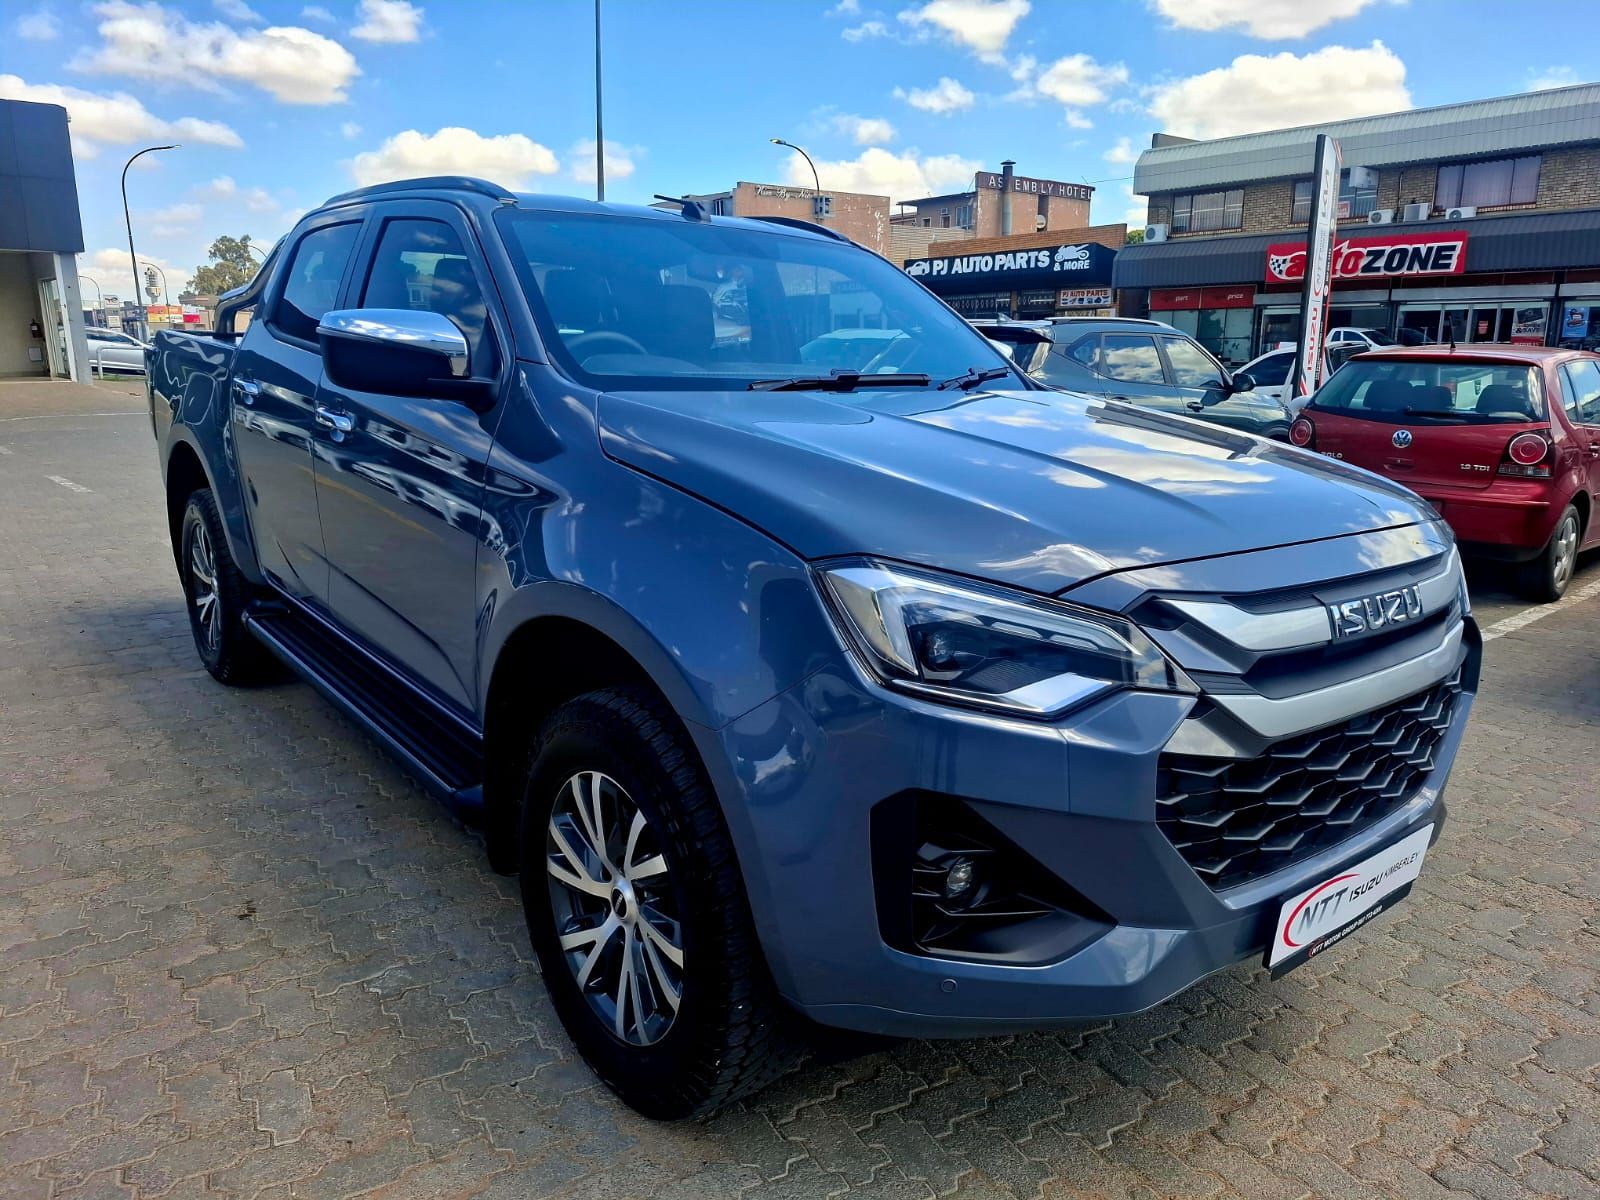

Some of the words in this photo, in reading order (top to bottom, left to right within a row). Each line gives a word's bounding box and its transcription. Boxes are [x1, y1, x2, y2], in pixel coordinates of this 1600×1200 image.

[988, 175, 1053, 195] ASEMBLY
[1059, 184, 1092, 200] HOTEL
[933, 259, 948, 276] PJ
[952, 255, 993, 274] AUTO
[995, 250, 1050, 271] PARTS
[1053, 262, 1061, 272] &
[1063, 260, 1090, 271] MORE
[1283, 241, 1458, 280] atoZONE
[1070, 290, 1085, 298] AUTO
[1086, 289, 1108, 297] PARTS
[1227, 293, 1244, 301] price
[1306, 307, 1318, 371] ISUZU
[1330, 585, 1422, 640] ISUZU
[1298, 886, 1350, 935] NTT
[1348, 873, 1384, 903] ISUZU
[1383, 852, 1419, 878] KIMBERLEY
